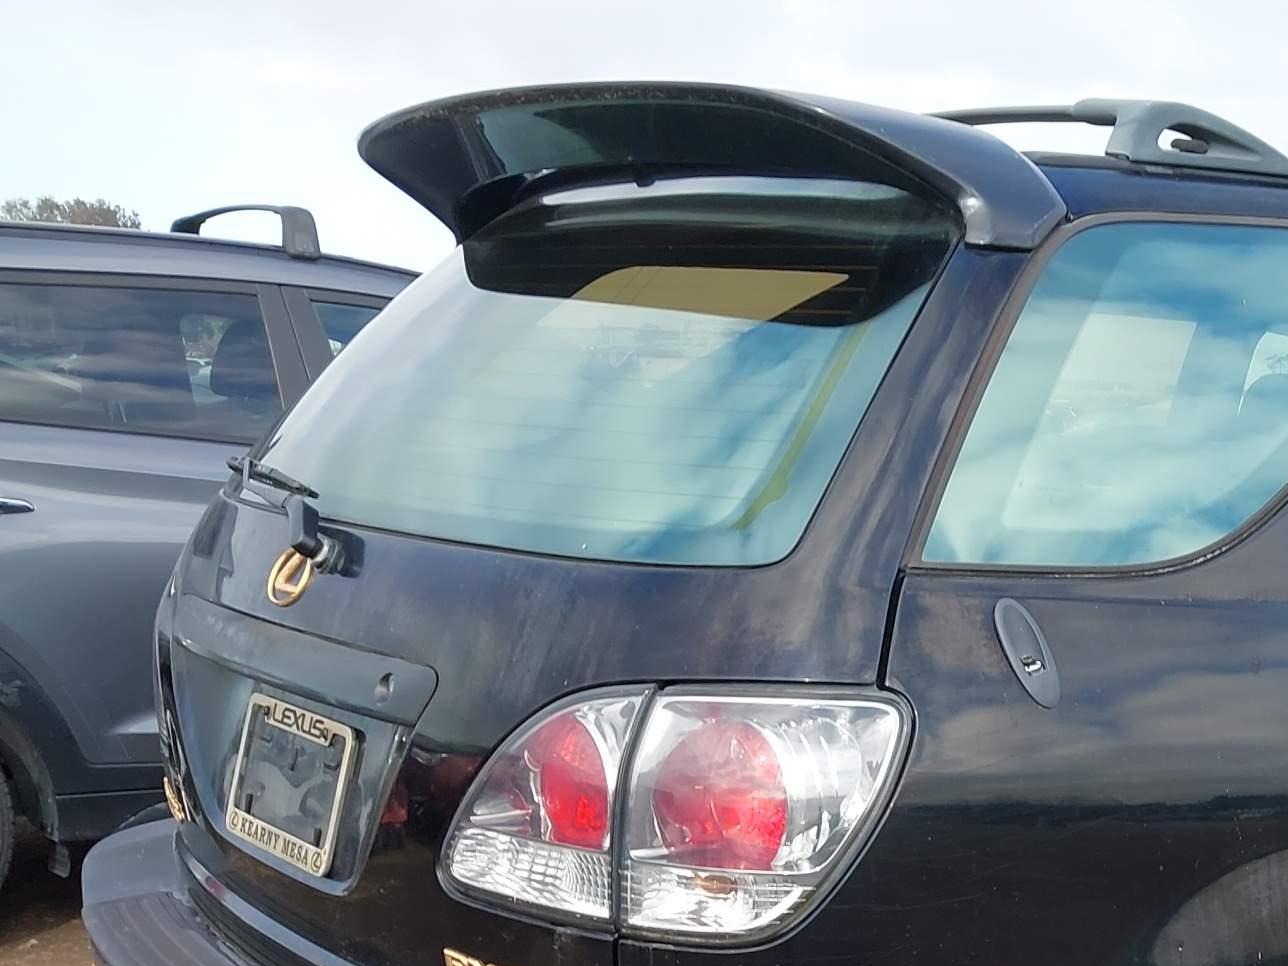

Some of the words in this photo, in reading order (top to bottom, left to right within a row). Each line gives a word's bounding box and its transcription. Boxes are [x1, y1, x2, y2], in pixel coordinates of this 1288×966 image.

[272, 702, 325, 740] LEXUS
[240, 816, 281, 851] KEARNY
[281, 837, 309, 867] MESA
